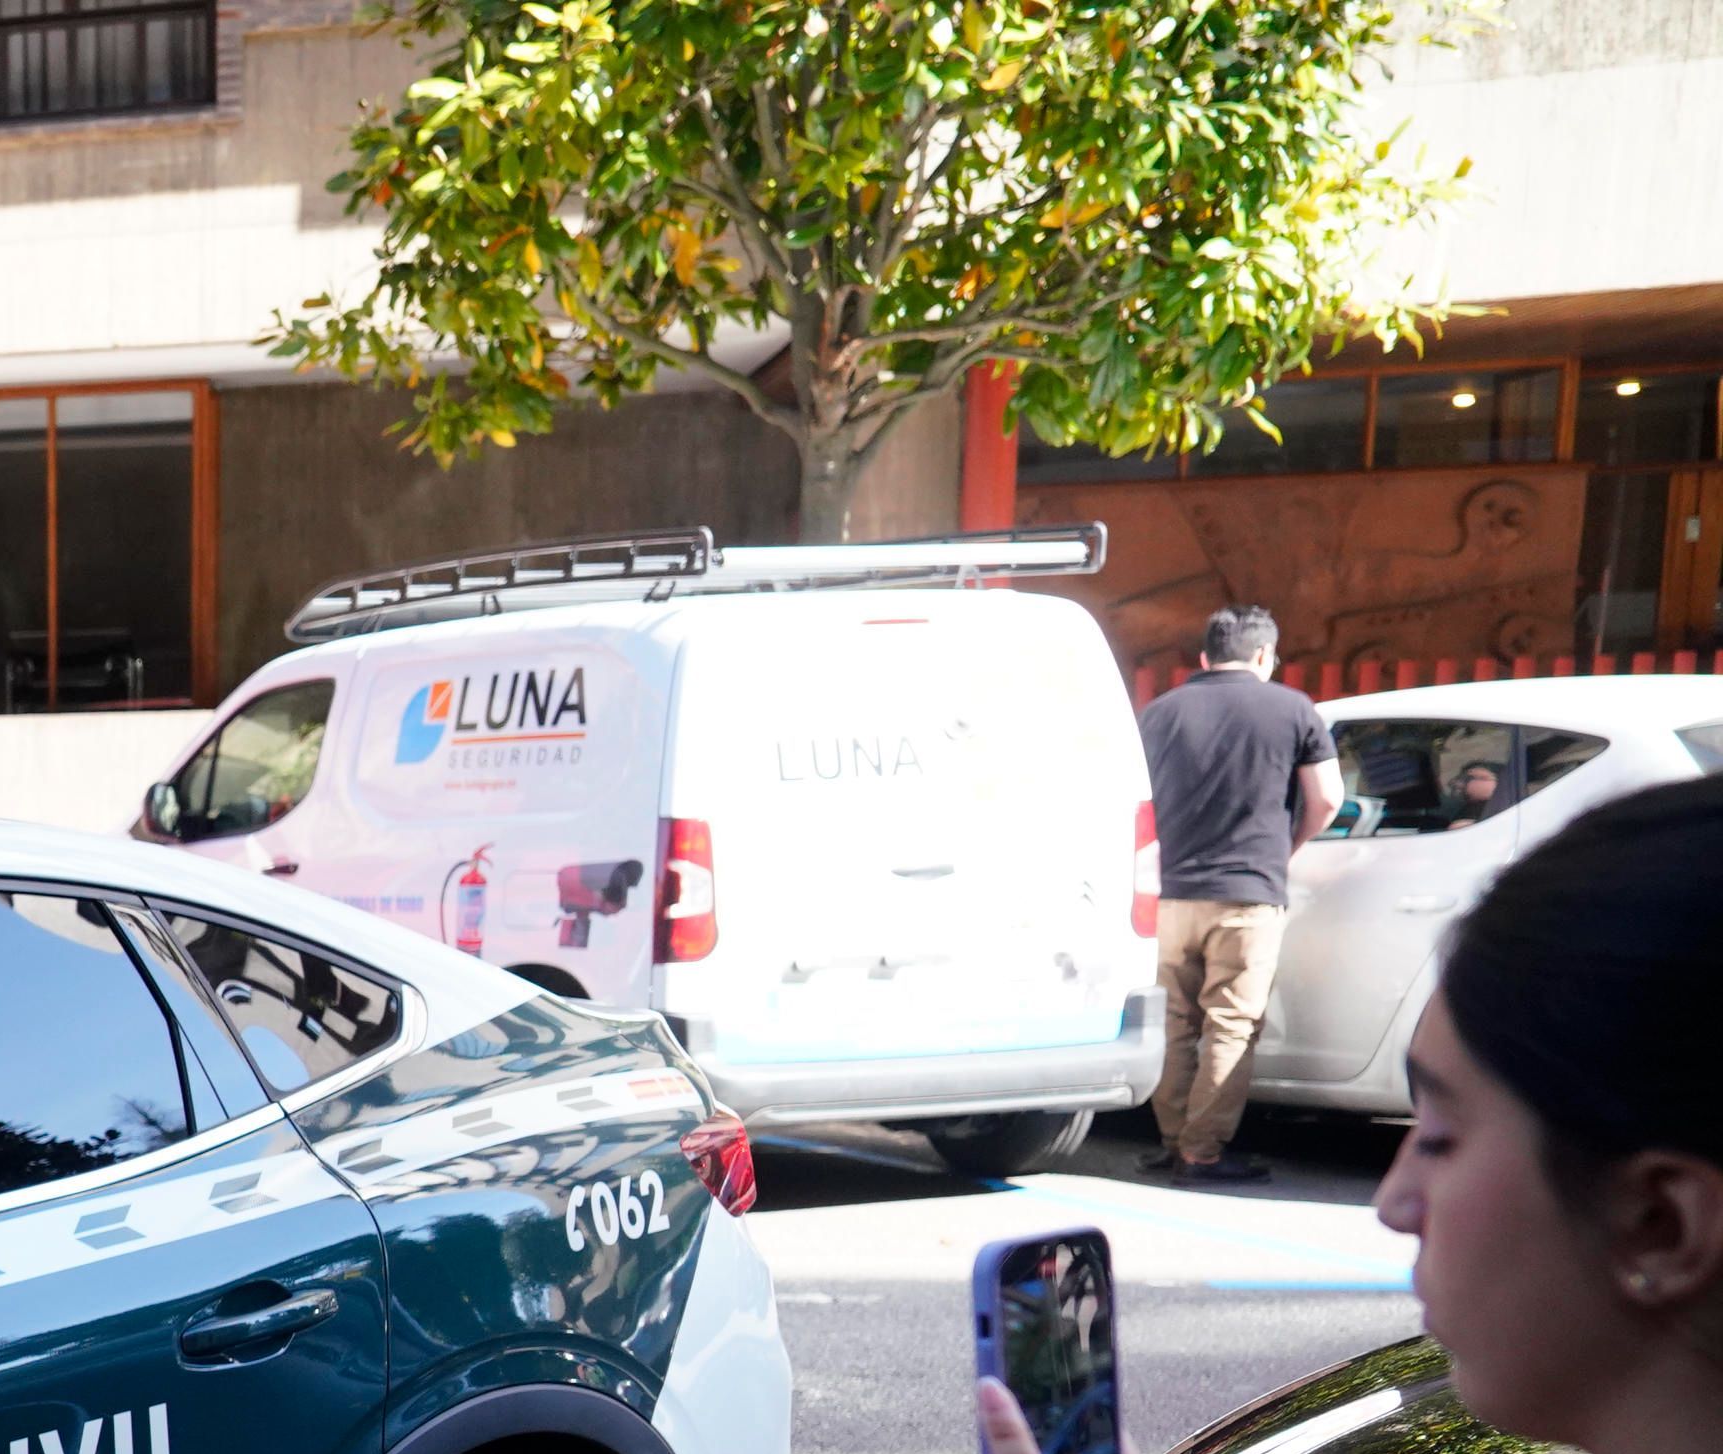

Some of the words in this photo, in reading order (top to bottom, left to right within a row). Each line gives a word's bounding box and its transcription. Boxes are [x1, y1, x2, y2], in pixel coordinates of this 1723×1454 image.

[455, 667, 586, 731] LUNA
[448, 746, 583, 768] SEGURIDAD
[776, 735, 924, 781] LUNA
[590, 1169, 670, 1245] 062
